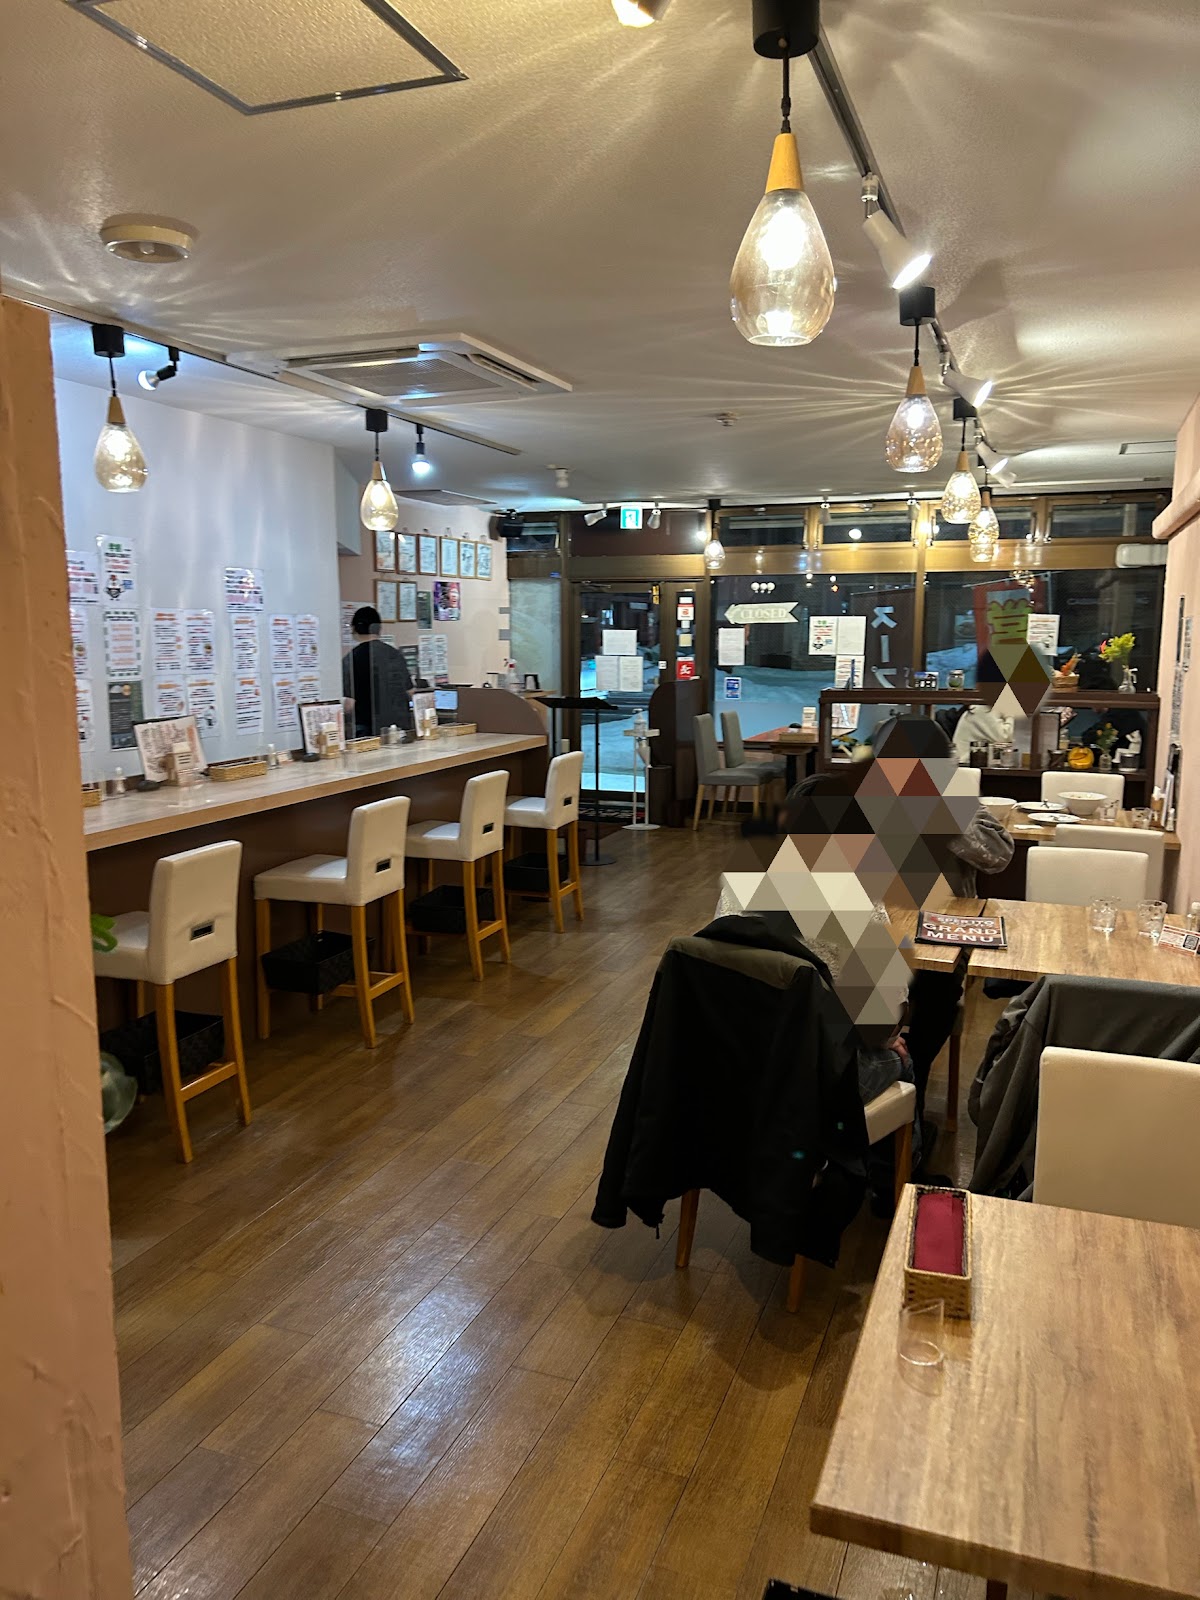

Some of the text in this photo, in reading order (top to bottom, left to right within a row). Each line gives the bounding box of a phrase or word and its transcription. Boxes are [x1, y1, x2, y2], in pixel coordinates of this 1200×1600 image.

[740, 607, 787, 619] CLOSED
[922, 922, 998, 935] GRAND
[926, 930, 994, 943] MENU
